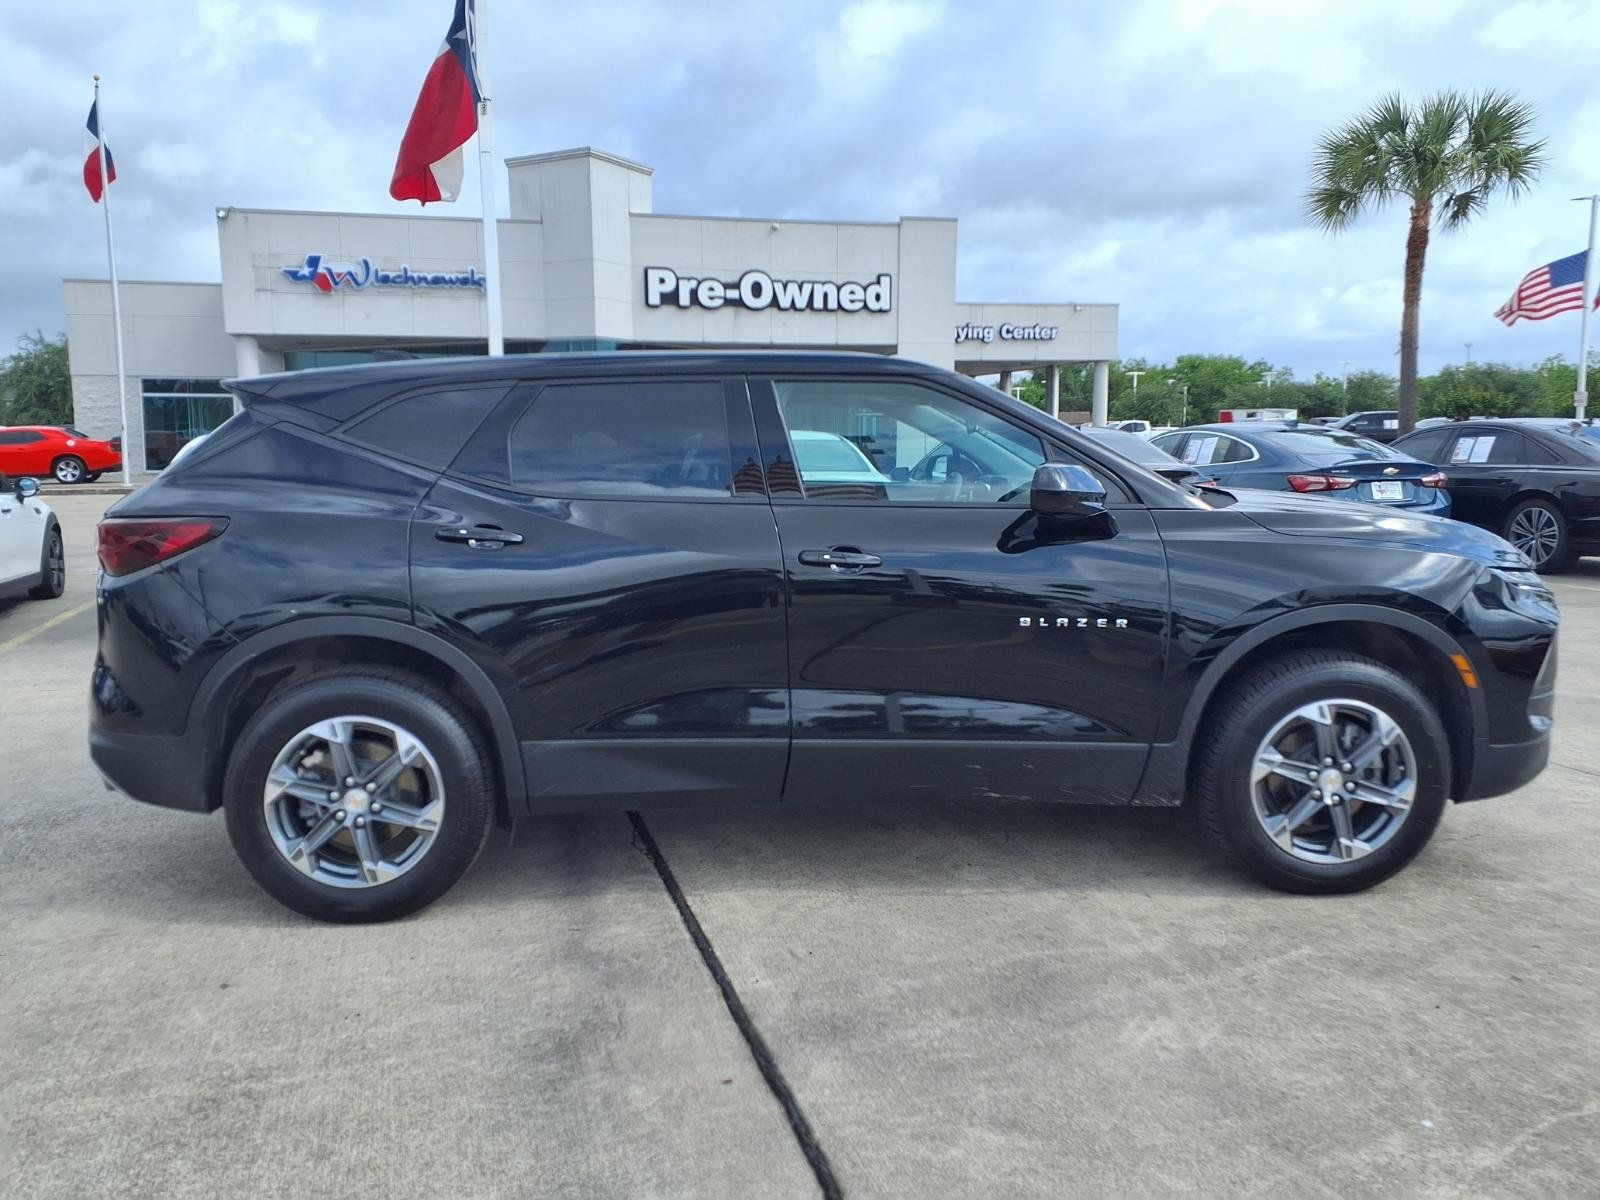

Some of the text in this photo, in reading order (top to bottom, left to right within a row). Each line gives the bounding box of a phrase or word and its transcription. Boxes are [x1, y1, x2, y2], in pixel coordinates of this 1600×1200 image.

[645, 267, 892, 313] Pre-Owned
[1000, 323, 1058, 340] Center
[1019, 617, 1129, 628] BLAZER
